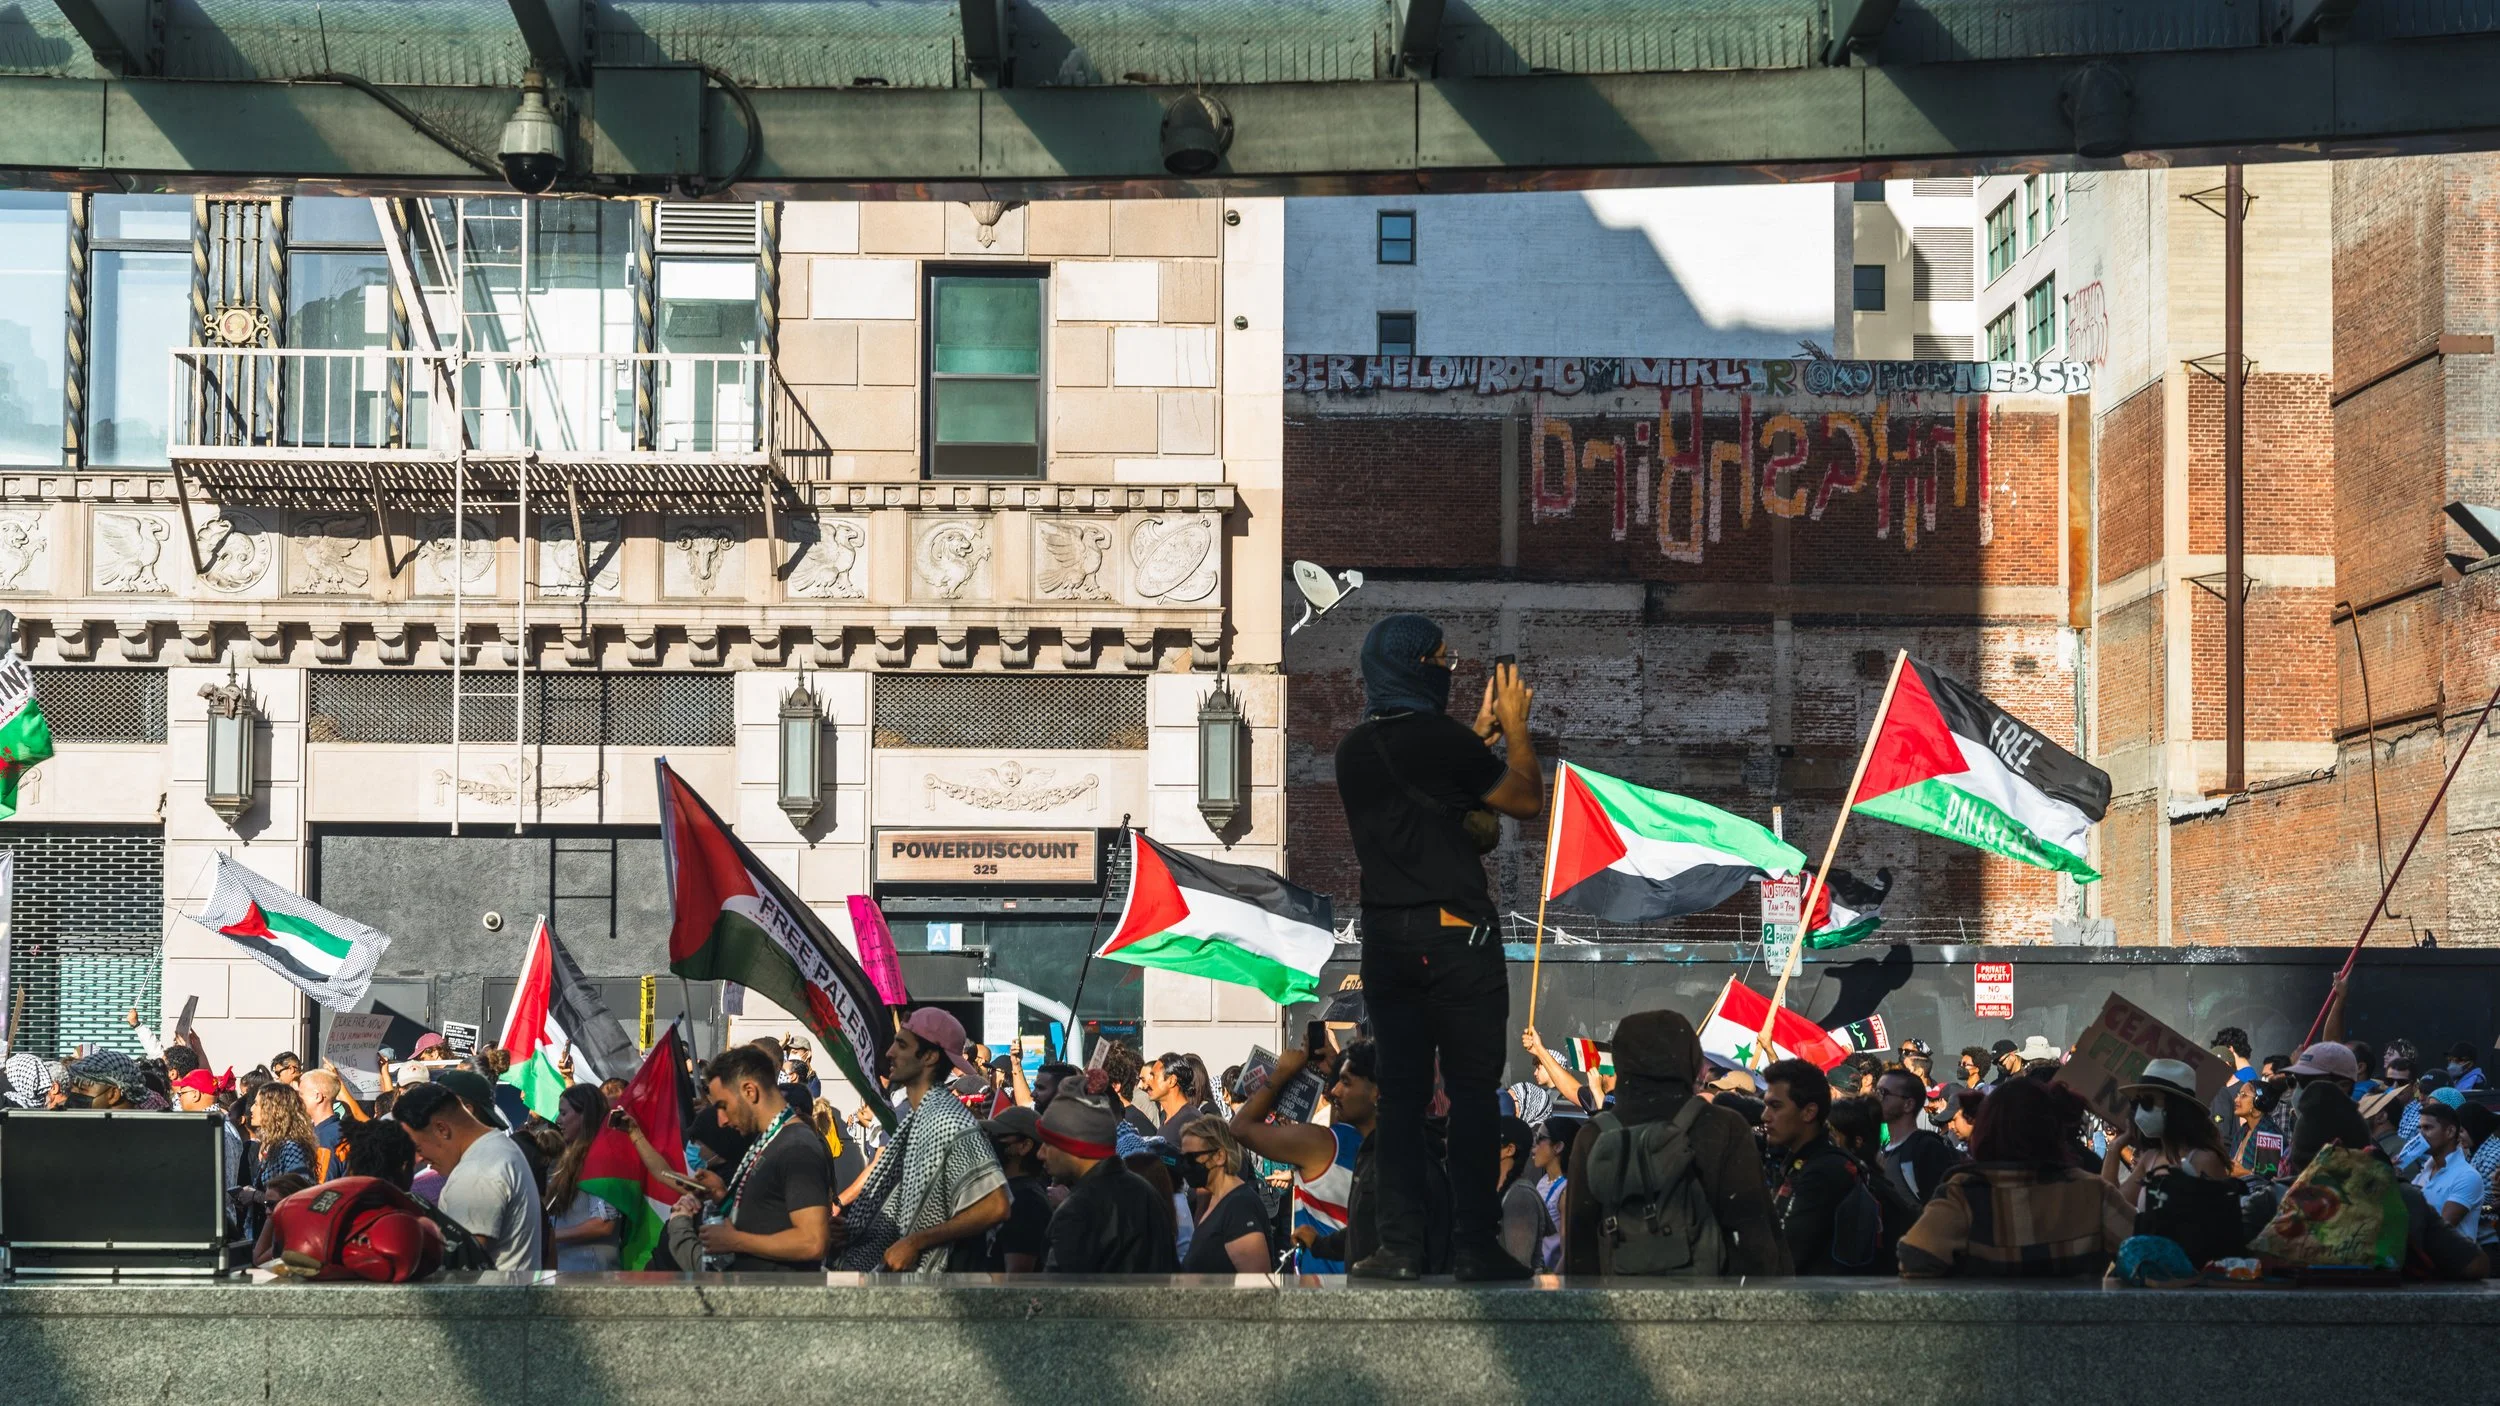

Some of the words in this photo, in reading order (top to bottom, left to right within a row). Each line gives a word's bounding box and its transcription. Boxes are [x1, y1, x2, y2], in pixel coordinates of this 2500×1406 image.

[1988, 714, 2044, 776] FREE
[892, 842, 1079, 859] POWERDISCOUNT
[973, 864, 998, 875] 325
[1764, 883, 1774, 898] NO
[1774, 885, 1799, 897] STOPPING
[758, 894, 813, 967] FREE
[931, 929, 947, 946] A
[1766, 925, 1773, 941] 2
[1977, 973, 2011, 981] PROPERTY
[1981, 965, 2006, 973] PRIVATE
[1988, 985, 2000, 993] NO
[1243, 1067, 1263, 1083] UAW
[1285, 1092, 1310, 1109] OSSES
